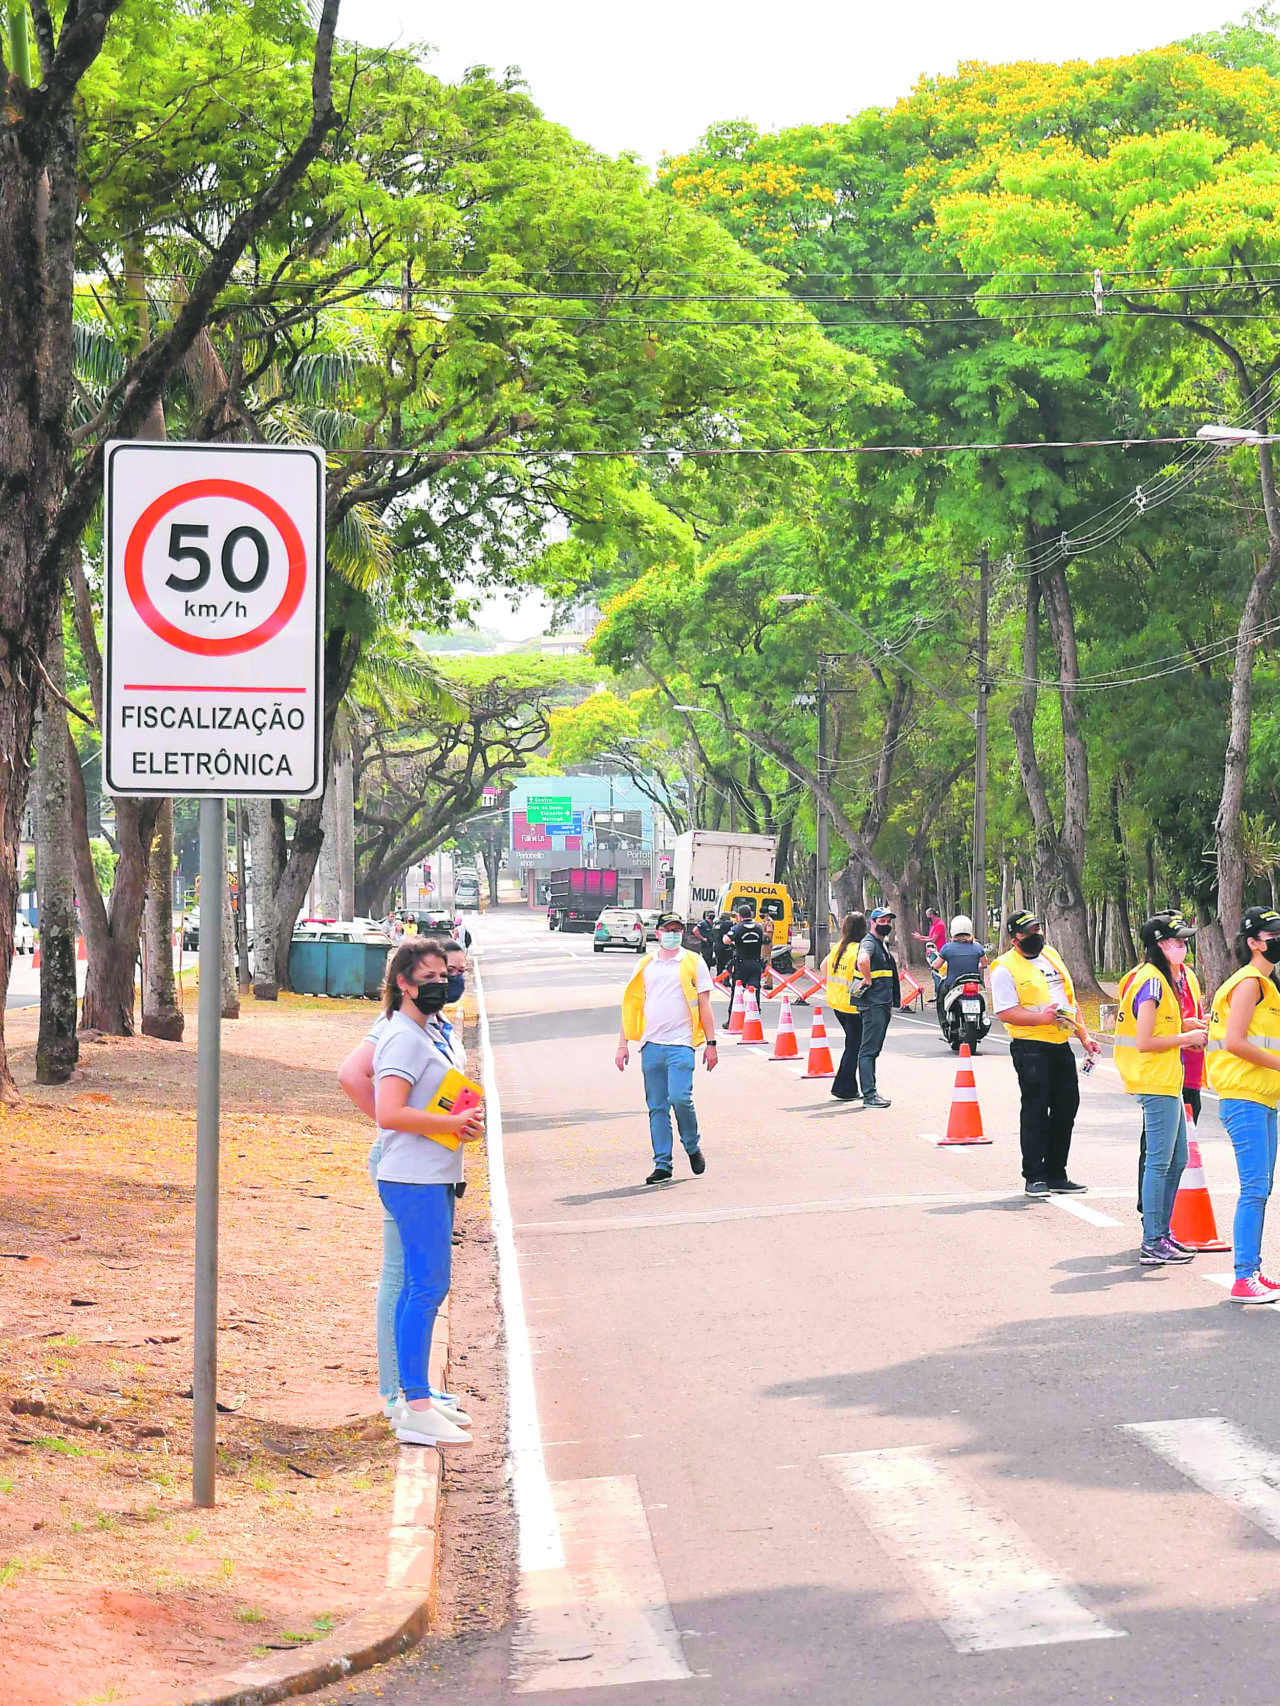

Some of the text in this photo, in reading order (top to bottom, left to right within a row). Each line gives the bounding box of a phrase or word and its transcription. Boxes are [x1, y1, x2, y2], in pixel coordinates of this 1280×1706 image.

[165, 523, 270, 593] 50
[184, 600, 247, 618] km/h
[121, 703, 305, 735] FISCALIZAÇÃO
[132, 748, 293, 777] ELETRÔNICA
